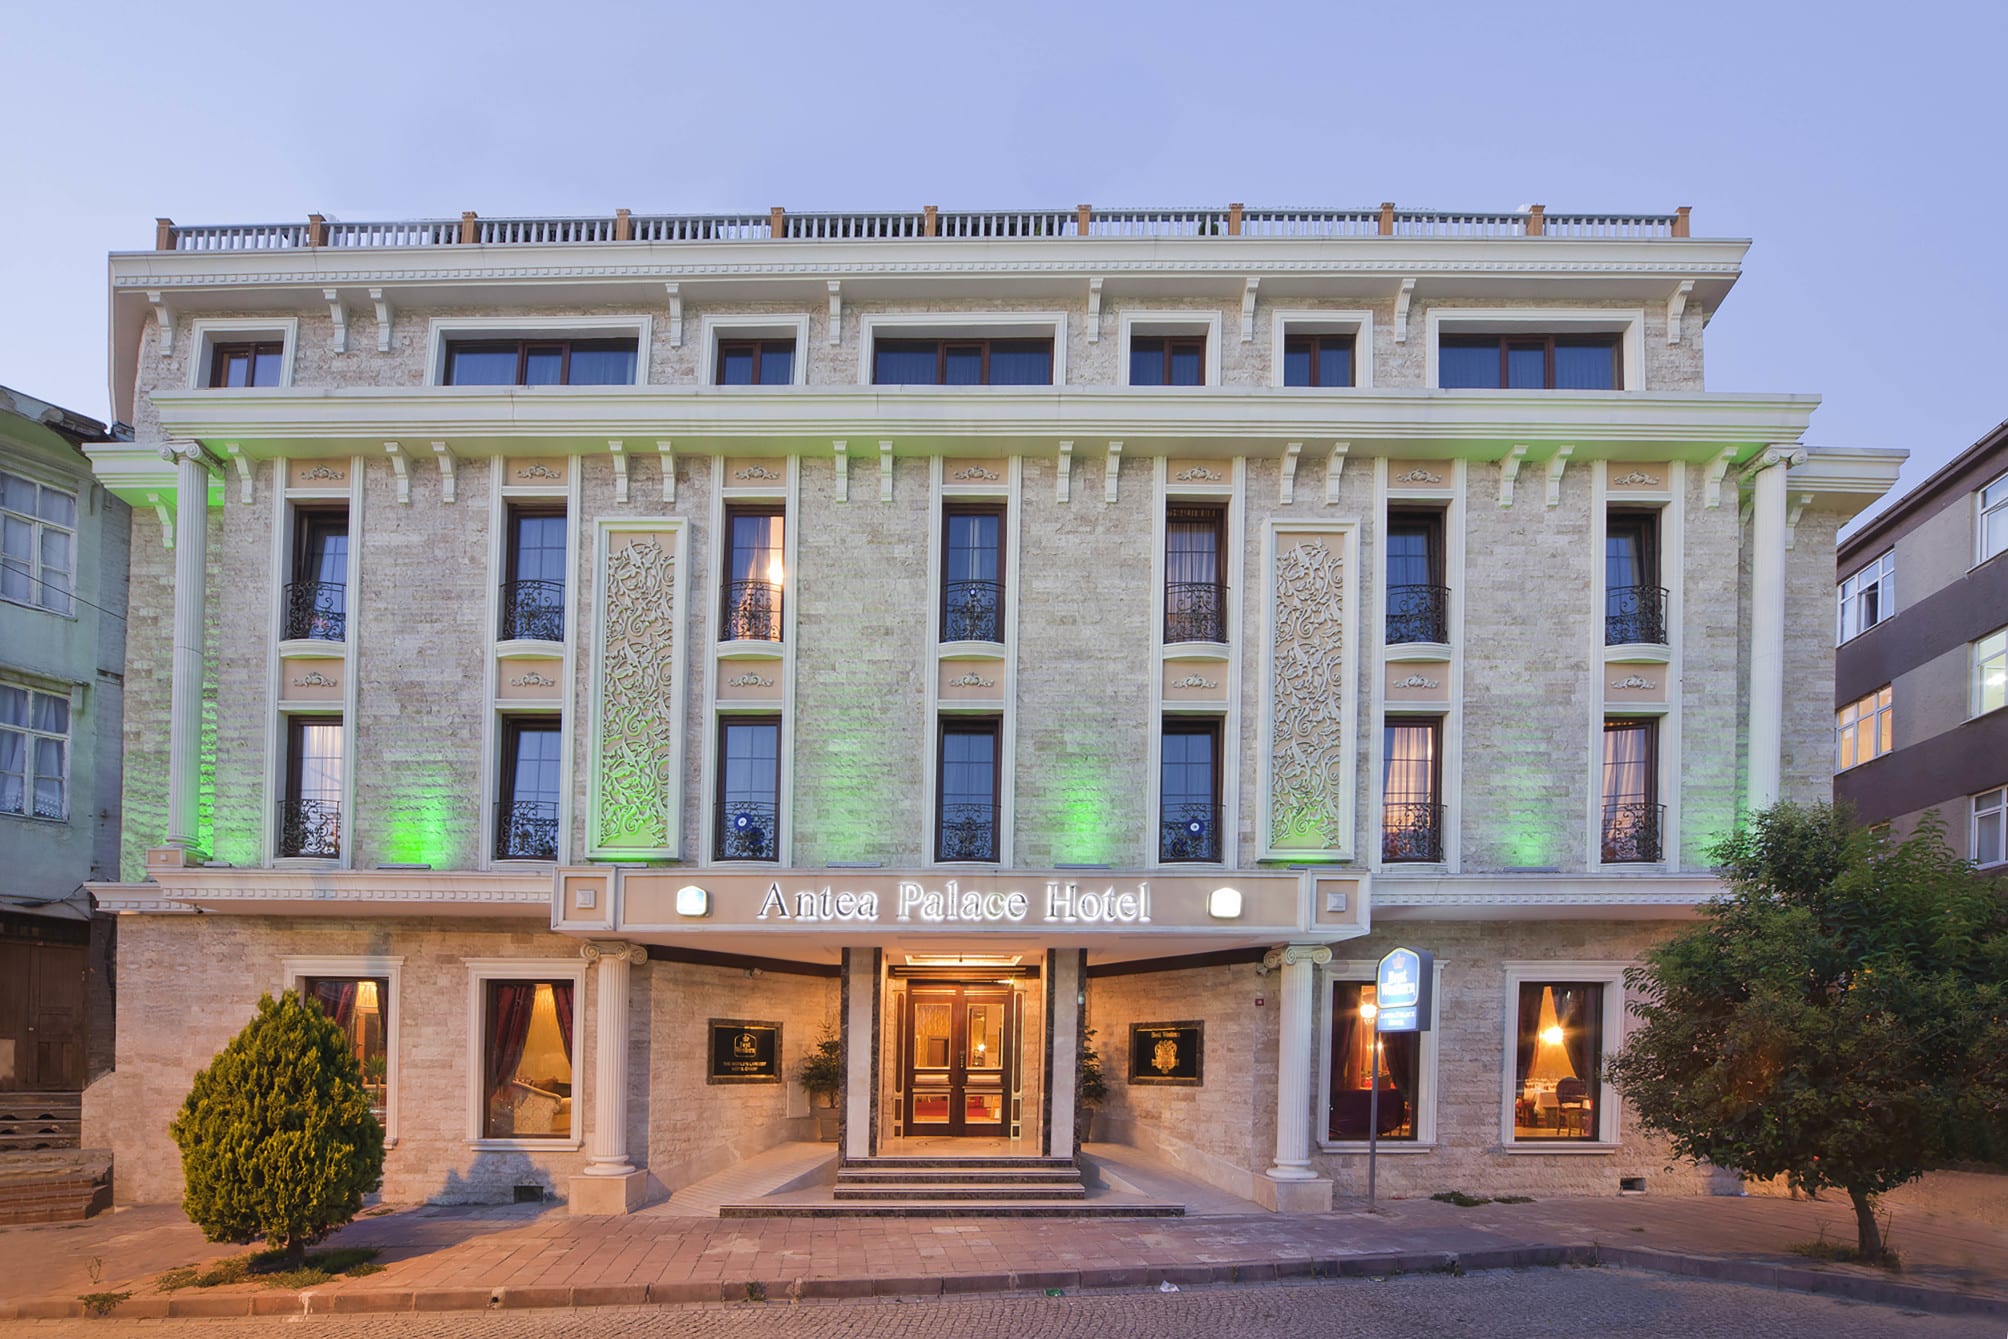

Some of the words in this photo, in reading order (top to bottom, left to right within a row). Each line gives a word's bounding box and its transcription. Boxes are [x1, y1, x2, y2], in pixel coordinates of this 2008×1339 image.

[756, 881, 879, 921] Antea
[896, 880, 1028, 922] Palace
[1043, 881, 1151, 922] Hotel
